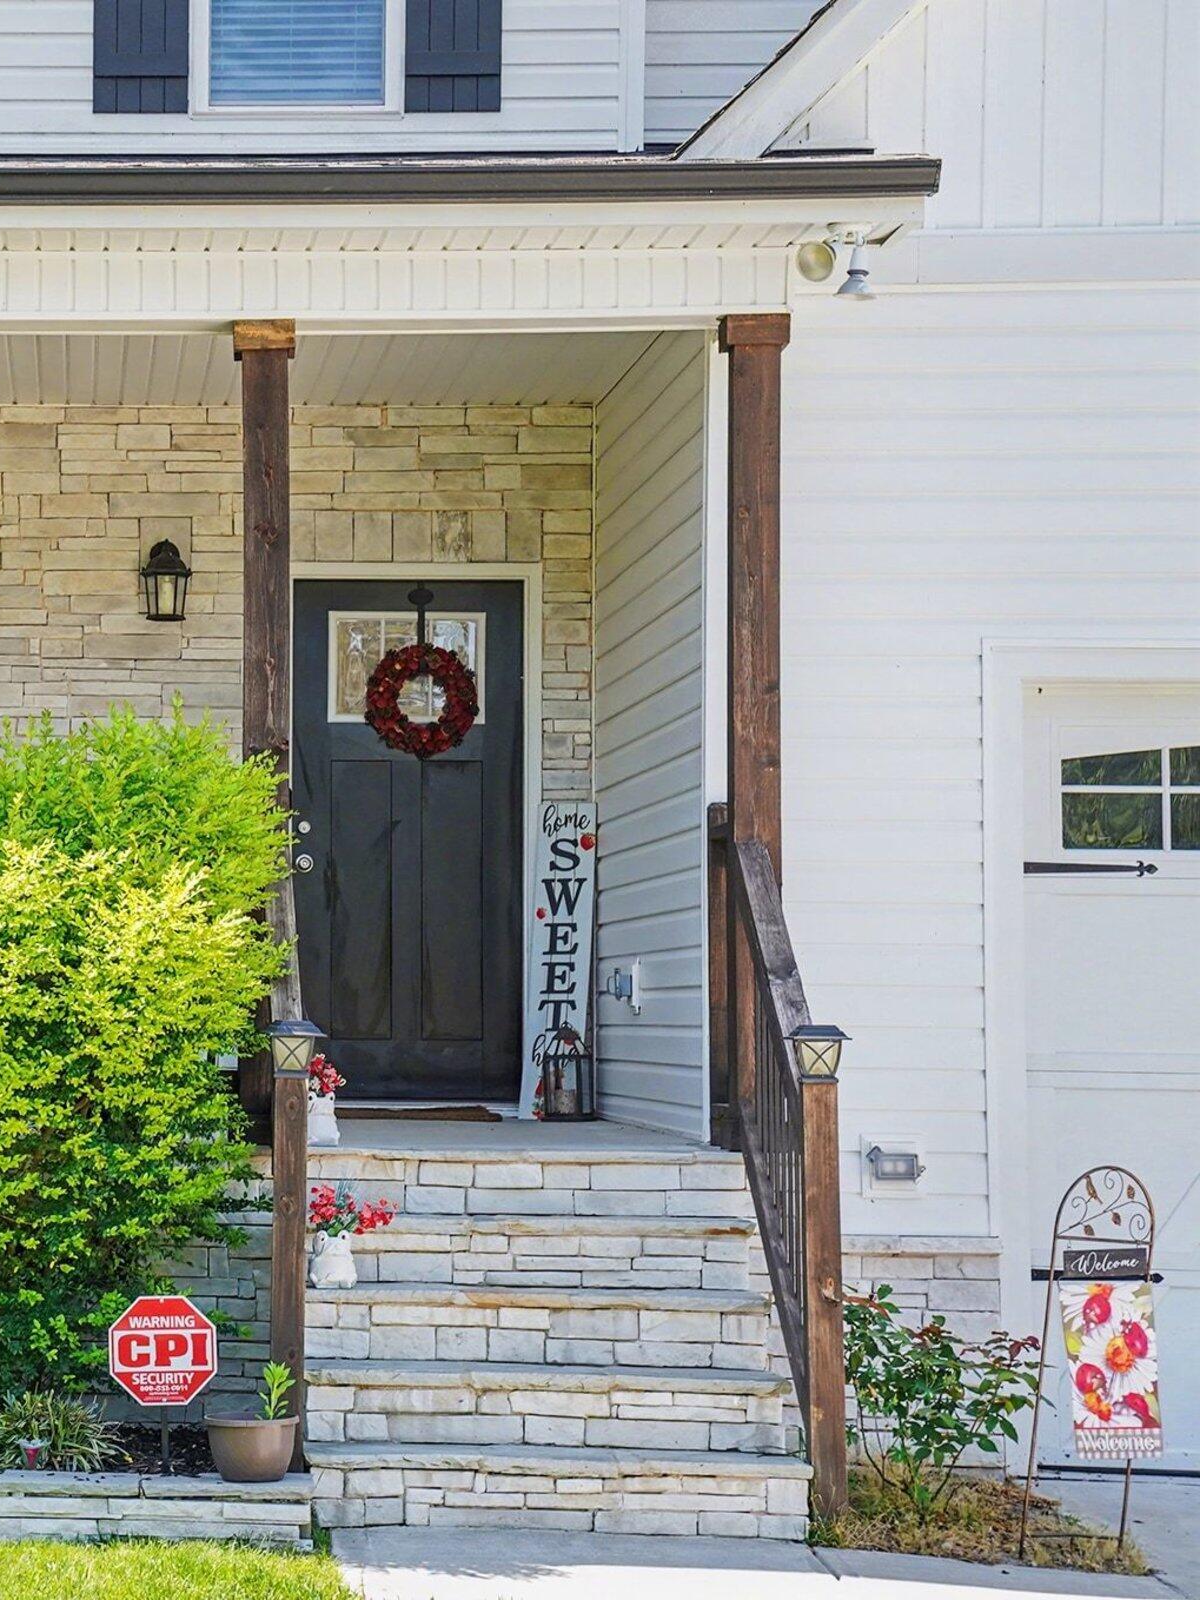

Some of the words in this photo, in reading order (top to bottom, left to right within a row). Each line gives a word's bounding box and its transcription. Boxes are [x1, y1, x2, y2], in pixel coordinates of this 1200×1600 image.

[542, 803, 590, 837] home
[538, 838, 588, 1032] SWEET
[1070, 1251, 1140, 1275] Welcome
[128, 1315, 195, 1328] WARNING
[118, 1333, 208, 1368] CPI
[131, 1372, 195, 1386] SECURITY
[1080, 1430, 1156, 1452] Welcome
